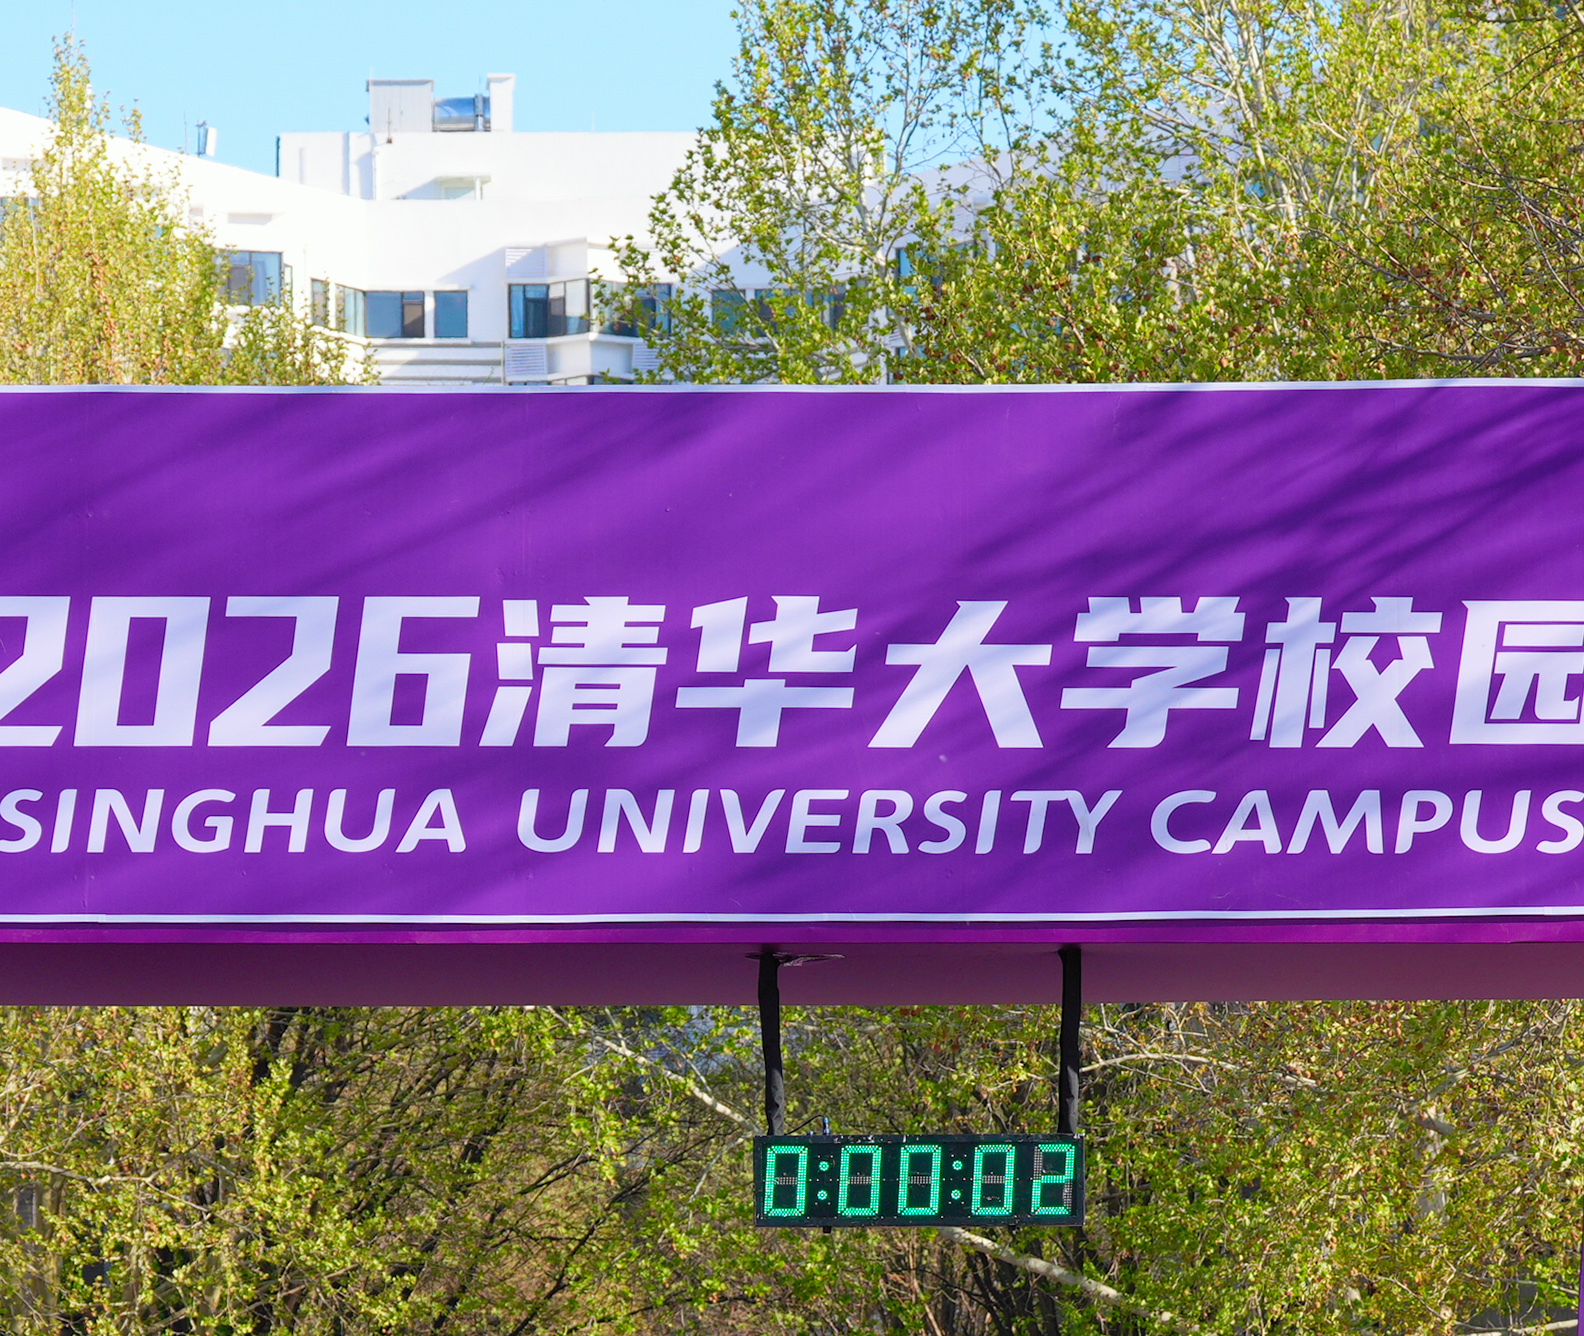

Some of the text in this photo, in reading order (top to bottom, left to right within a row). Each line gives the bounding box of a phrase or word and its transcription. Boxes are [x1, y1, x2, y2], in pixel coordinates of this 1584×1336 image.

[517, 788, 1122, 854] UNIVERSITY
[1150, 789, 1584, 854] CAMPUS
[764, 1145, 1075, 1217] 0:00:02
